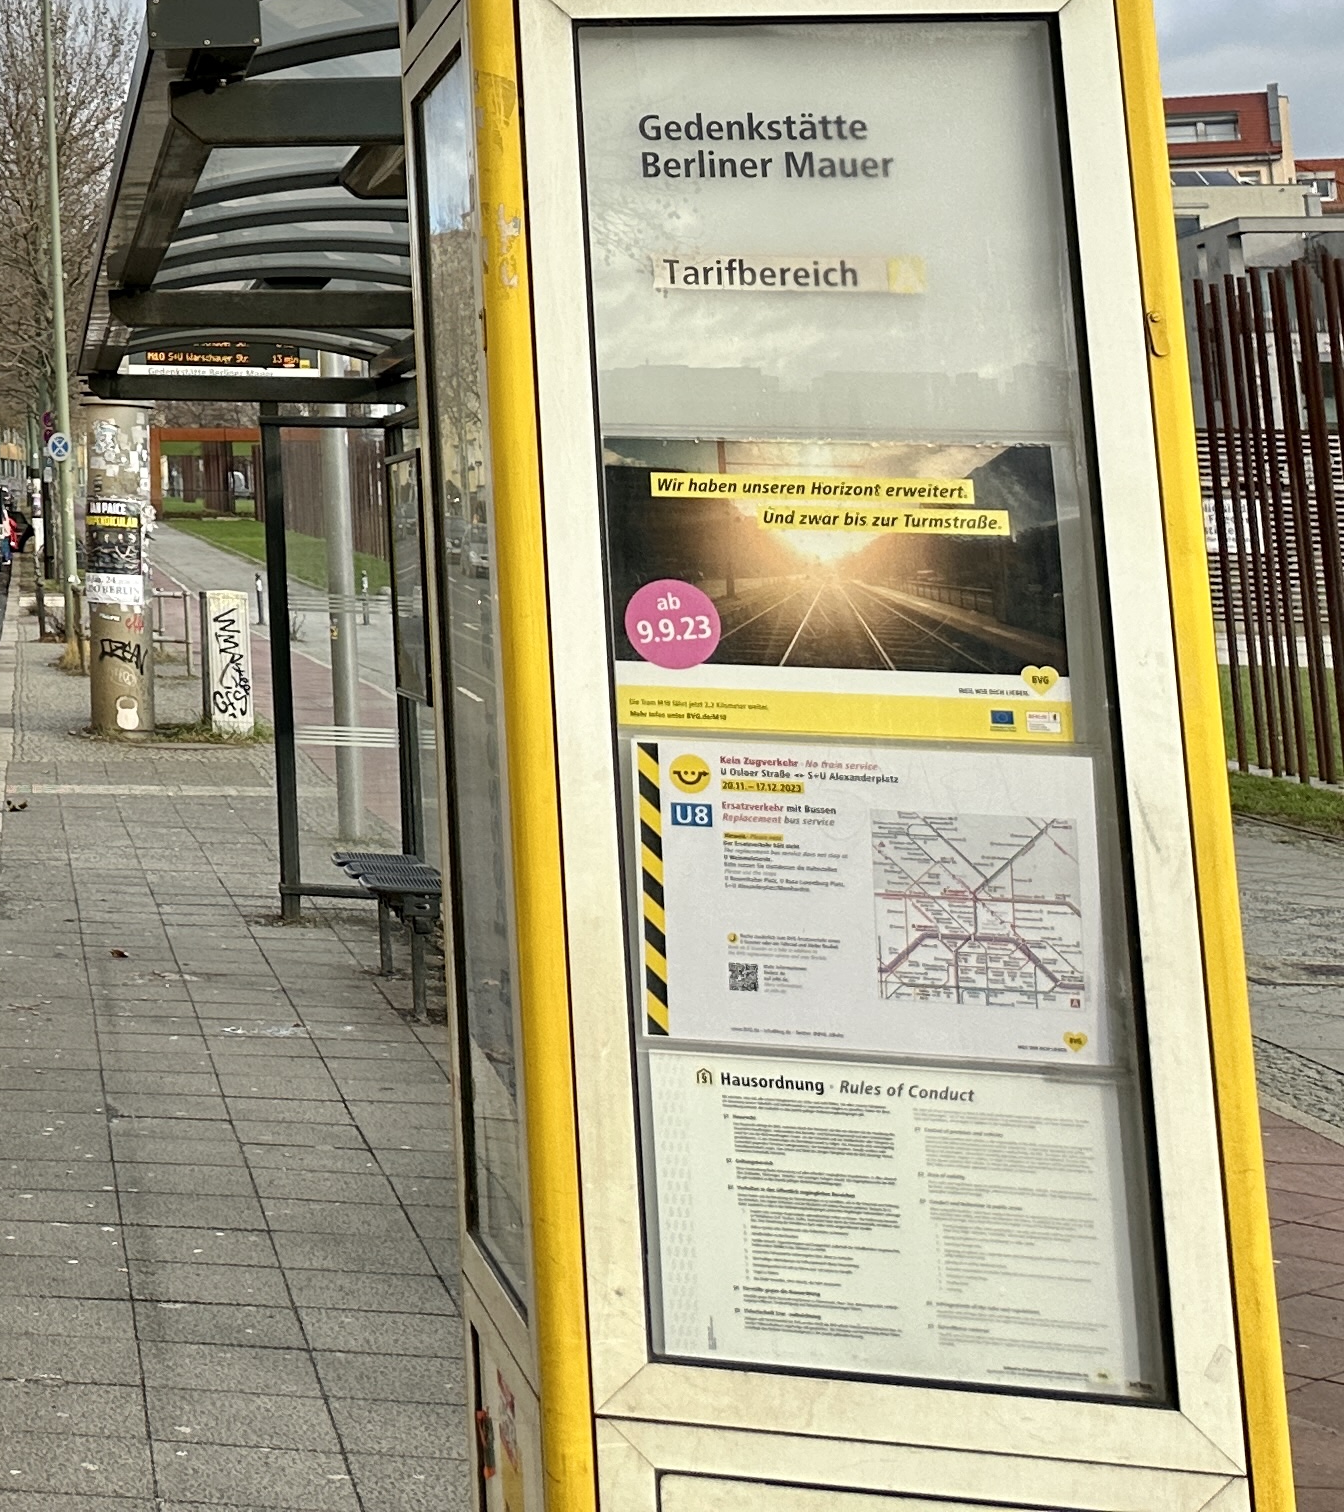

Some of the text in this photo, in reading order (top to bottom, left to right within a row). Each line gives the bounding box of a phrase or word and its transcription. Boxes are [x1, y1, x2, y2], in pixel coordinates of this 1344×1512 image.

[638, 112, 868, 142] Gedenkstätte
[640, 150, 894, 179] Berliner Mauer
[662, 258, 859, 288] Tarifbereich
[146, 351, 166, 361] M10
[657, 478, 968, 499] Wir haben unseren Horizont erweitert.
[763, 510, 1003, 530] Und zwar bis zur Turmstraße.
[656, 592, 681, 611] ab
[636, 615, 712, 644] 9.9.23
[1031, 676, 1050, 685] BVG
[719, 756, 879, 771] Kein Zugverkehr No train service
[720, 768, 899, 784] U Osloer Straße S+U Alexanderplatz
[675, 804, 709, 825] U8
[721, 801, 837, 815] Ersatzverkehr mit Bussen
[722, 813, 835, 826] Replacement bus service
[720, 1071, 976, 1103] Hausordnung Rules of Conduct
